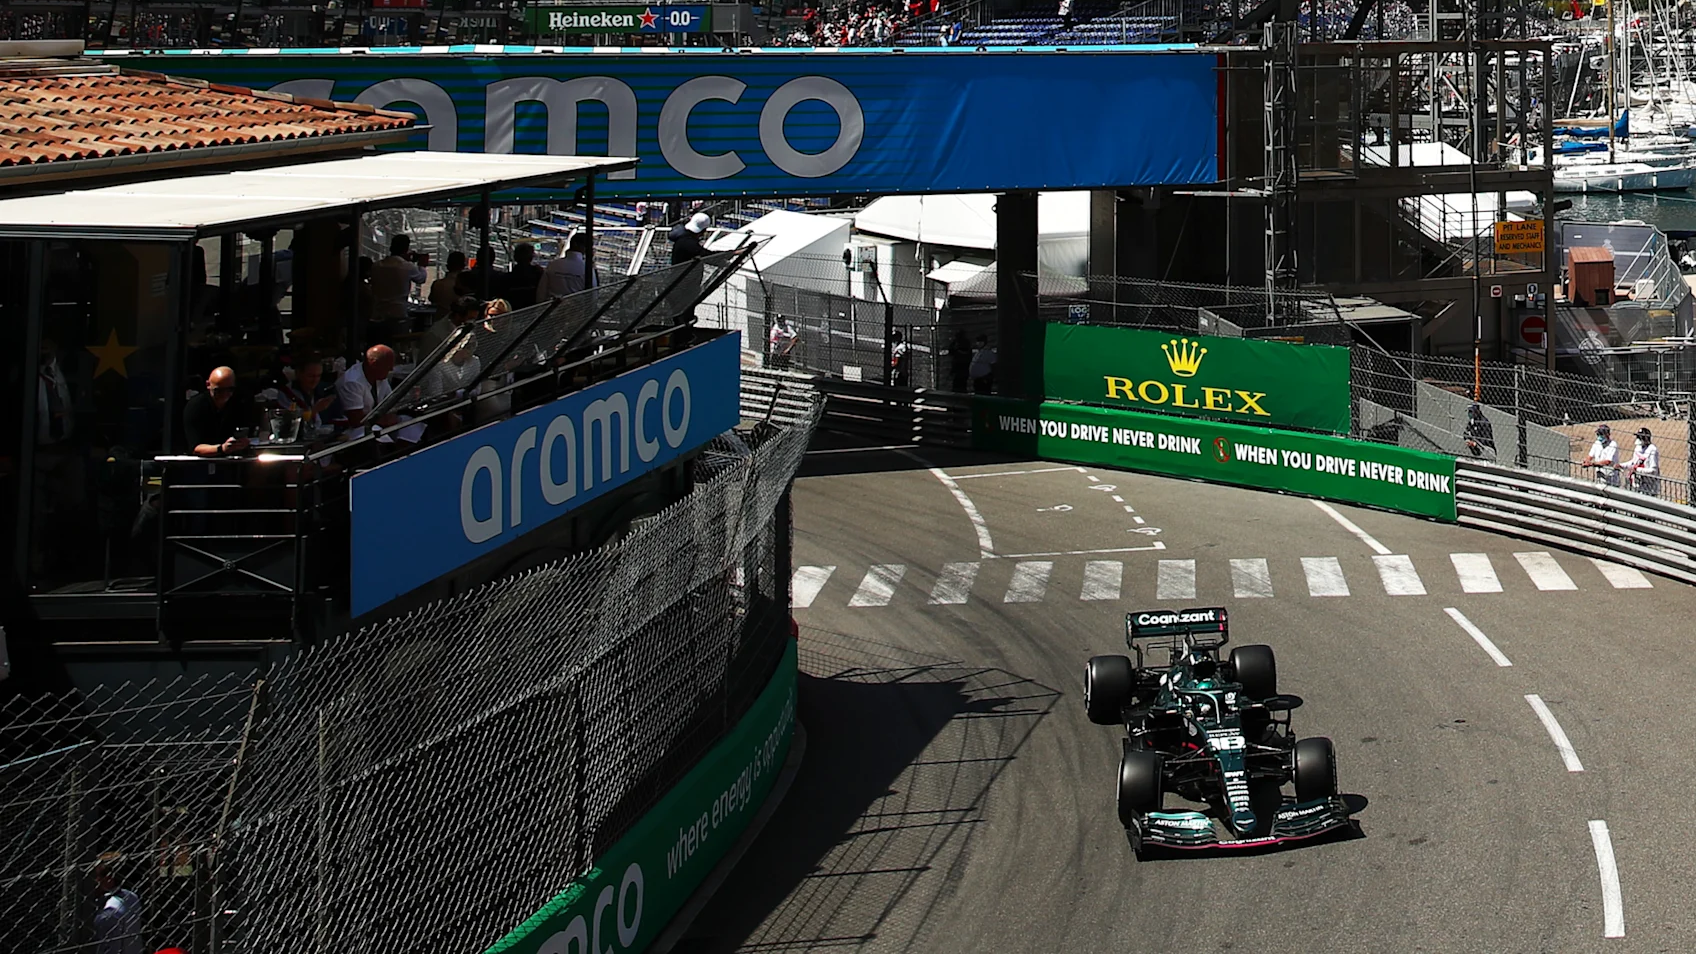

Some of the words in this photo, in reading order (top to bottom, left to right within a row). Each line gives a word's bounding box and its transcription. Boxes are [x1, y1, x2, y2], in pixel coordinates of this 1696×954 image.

[549, 11, 634, 30] Heineken
[266, 75, 866, 181] amco
[1104, 376, 1271, 416] ROLEX
[999, 415, 1037, 434] WHEN
[1039, 420, 1067, 438] YOU
[1071, 423, 1109, 443] DRIVE
[1113, 427, 1155, 448] NEVER
[1158, 433, 1201, 455] DRINK
[461, 368, 691, 544] aramco
[1234, 443, 1277, 465] WHEN
[1281, 449, 1312, 470] YOU
[1316, 454, 1356, 477] DRIVE
[1360, 461, 1404, 485] NEVER
[1407, 467, 1451, 494] DRINK
[1138, 609, 1215, 625] Cognzant
[1207, 736, 1247, 751] 18
[667, 812, 708, 879] where
[712, 762, 752, 829] energy
[753, 746, 762, 781] is
[1155, 819, 1178, 827] ASTON
[1277, 811, 1299, 820] ASTON
[1299, 805, 1324, 815] MARTIN
